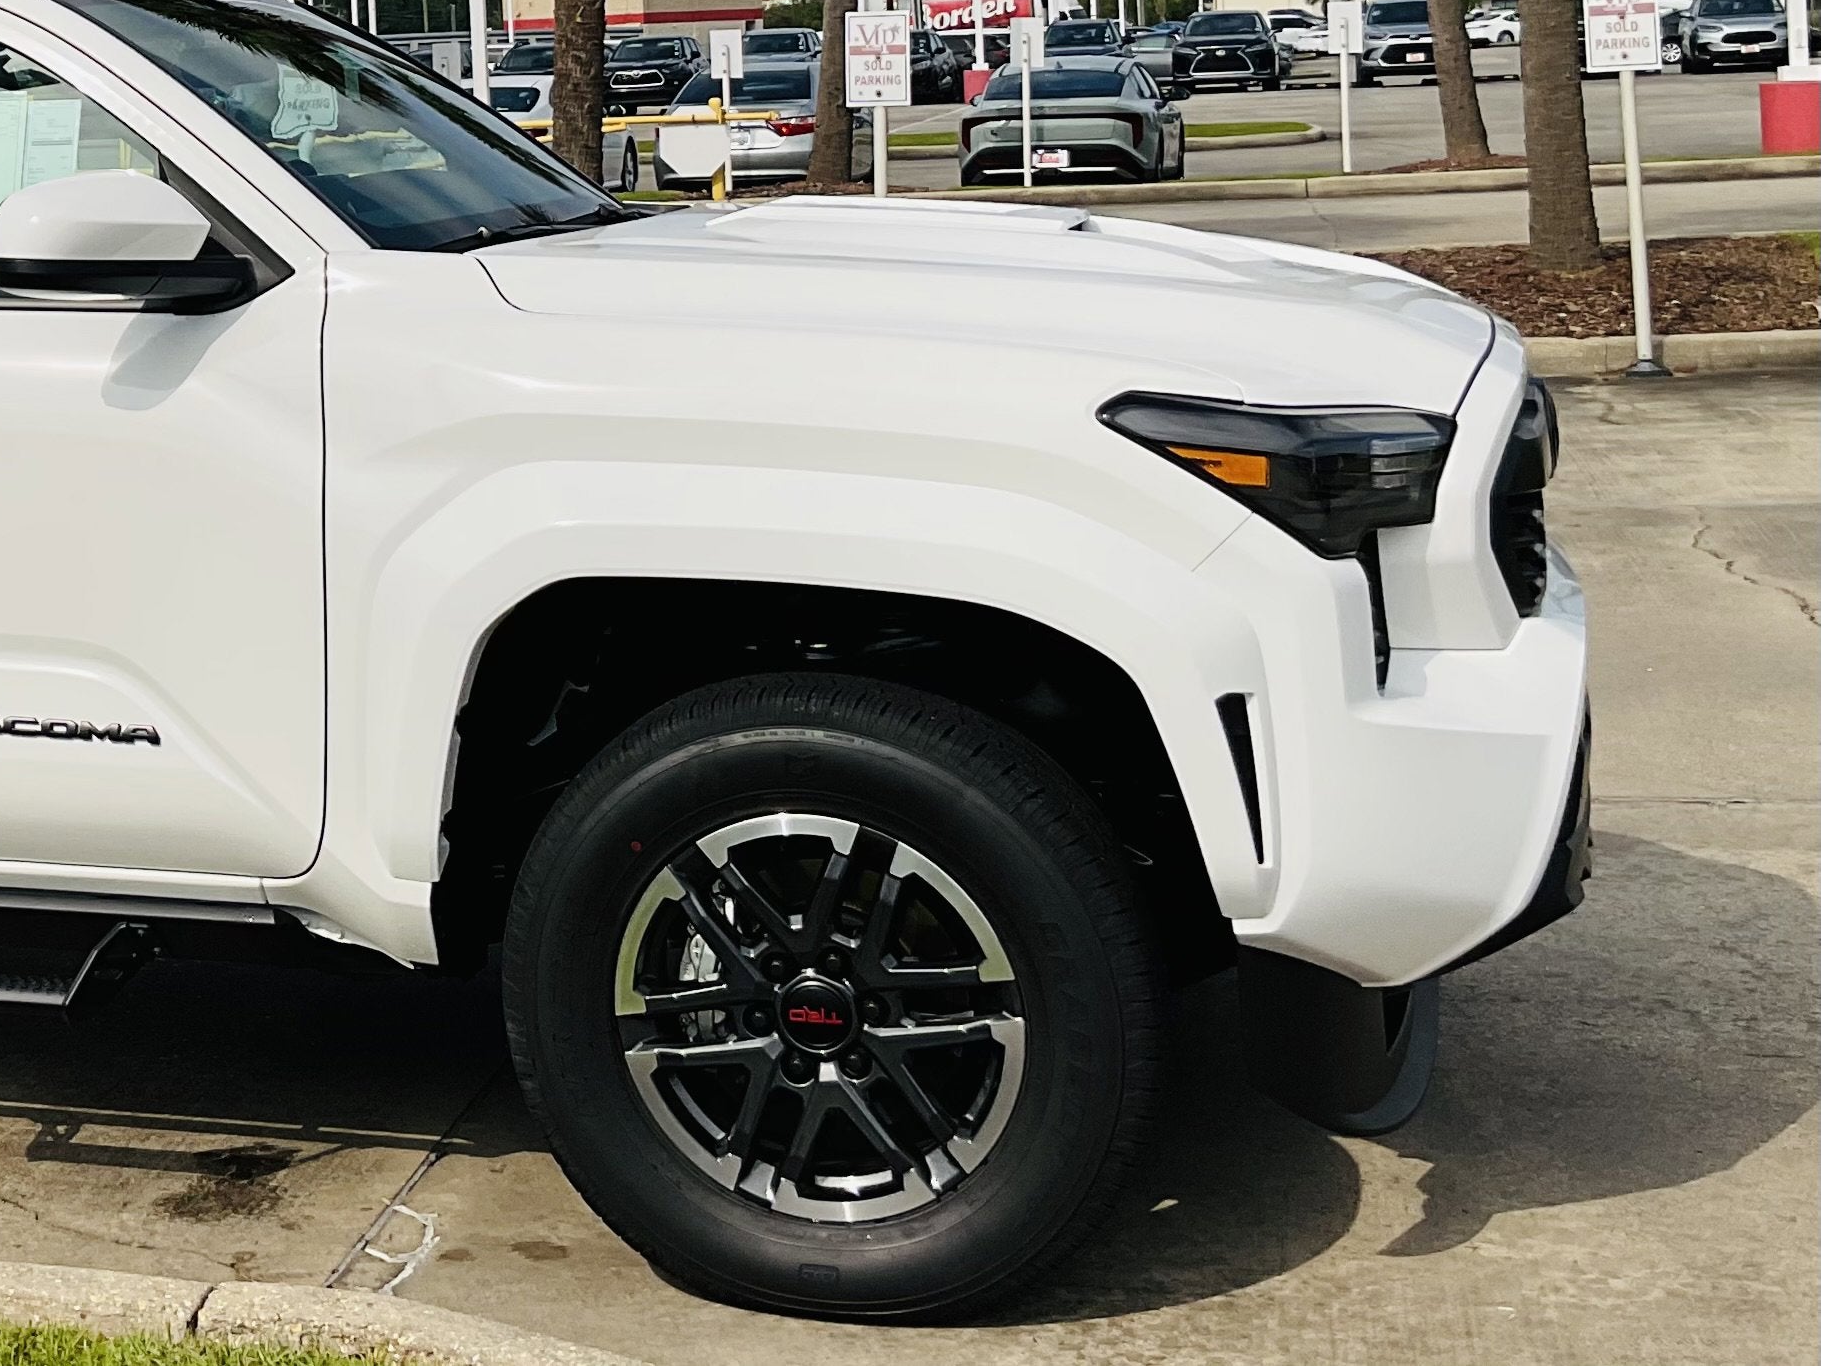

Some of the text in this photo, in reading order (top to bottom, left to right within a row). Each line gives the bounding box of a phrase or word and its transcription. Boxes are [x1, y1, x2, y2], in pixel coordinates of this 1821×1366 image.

[1605, 20, 1639, 34] SOLD
[1595, 36, 1651, 50] PARKING
[863, 60, 892, 72] SOLD
[854, 74, 903, 87] PARKING
[788, 1005, 844, 1025] TRD
